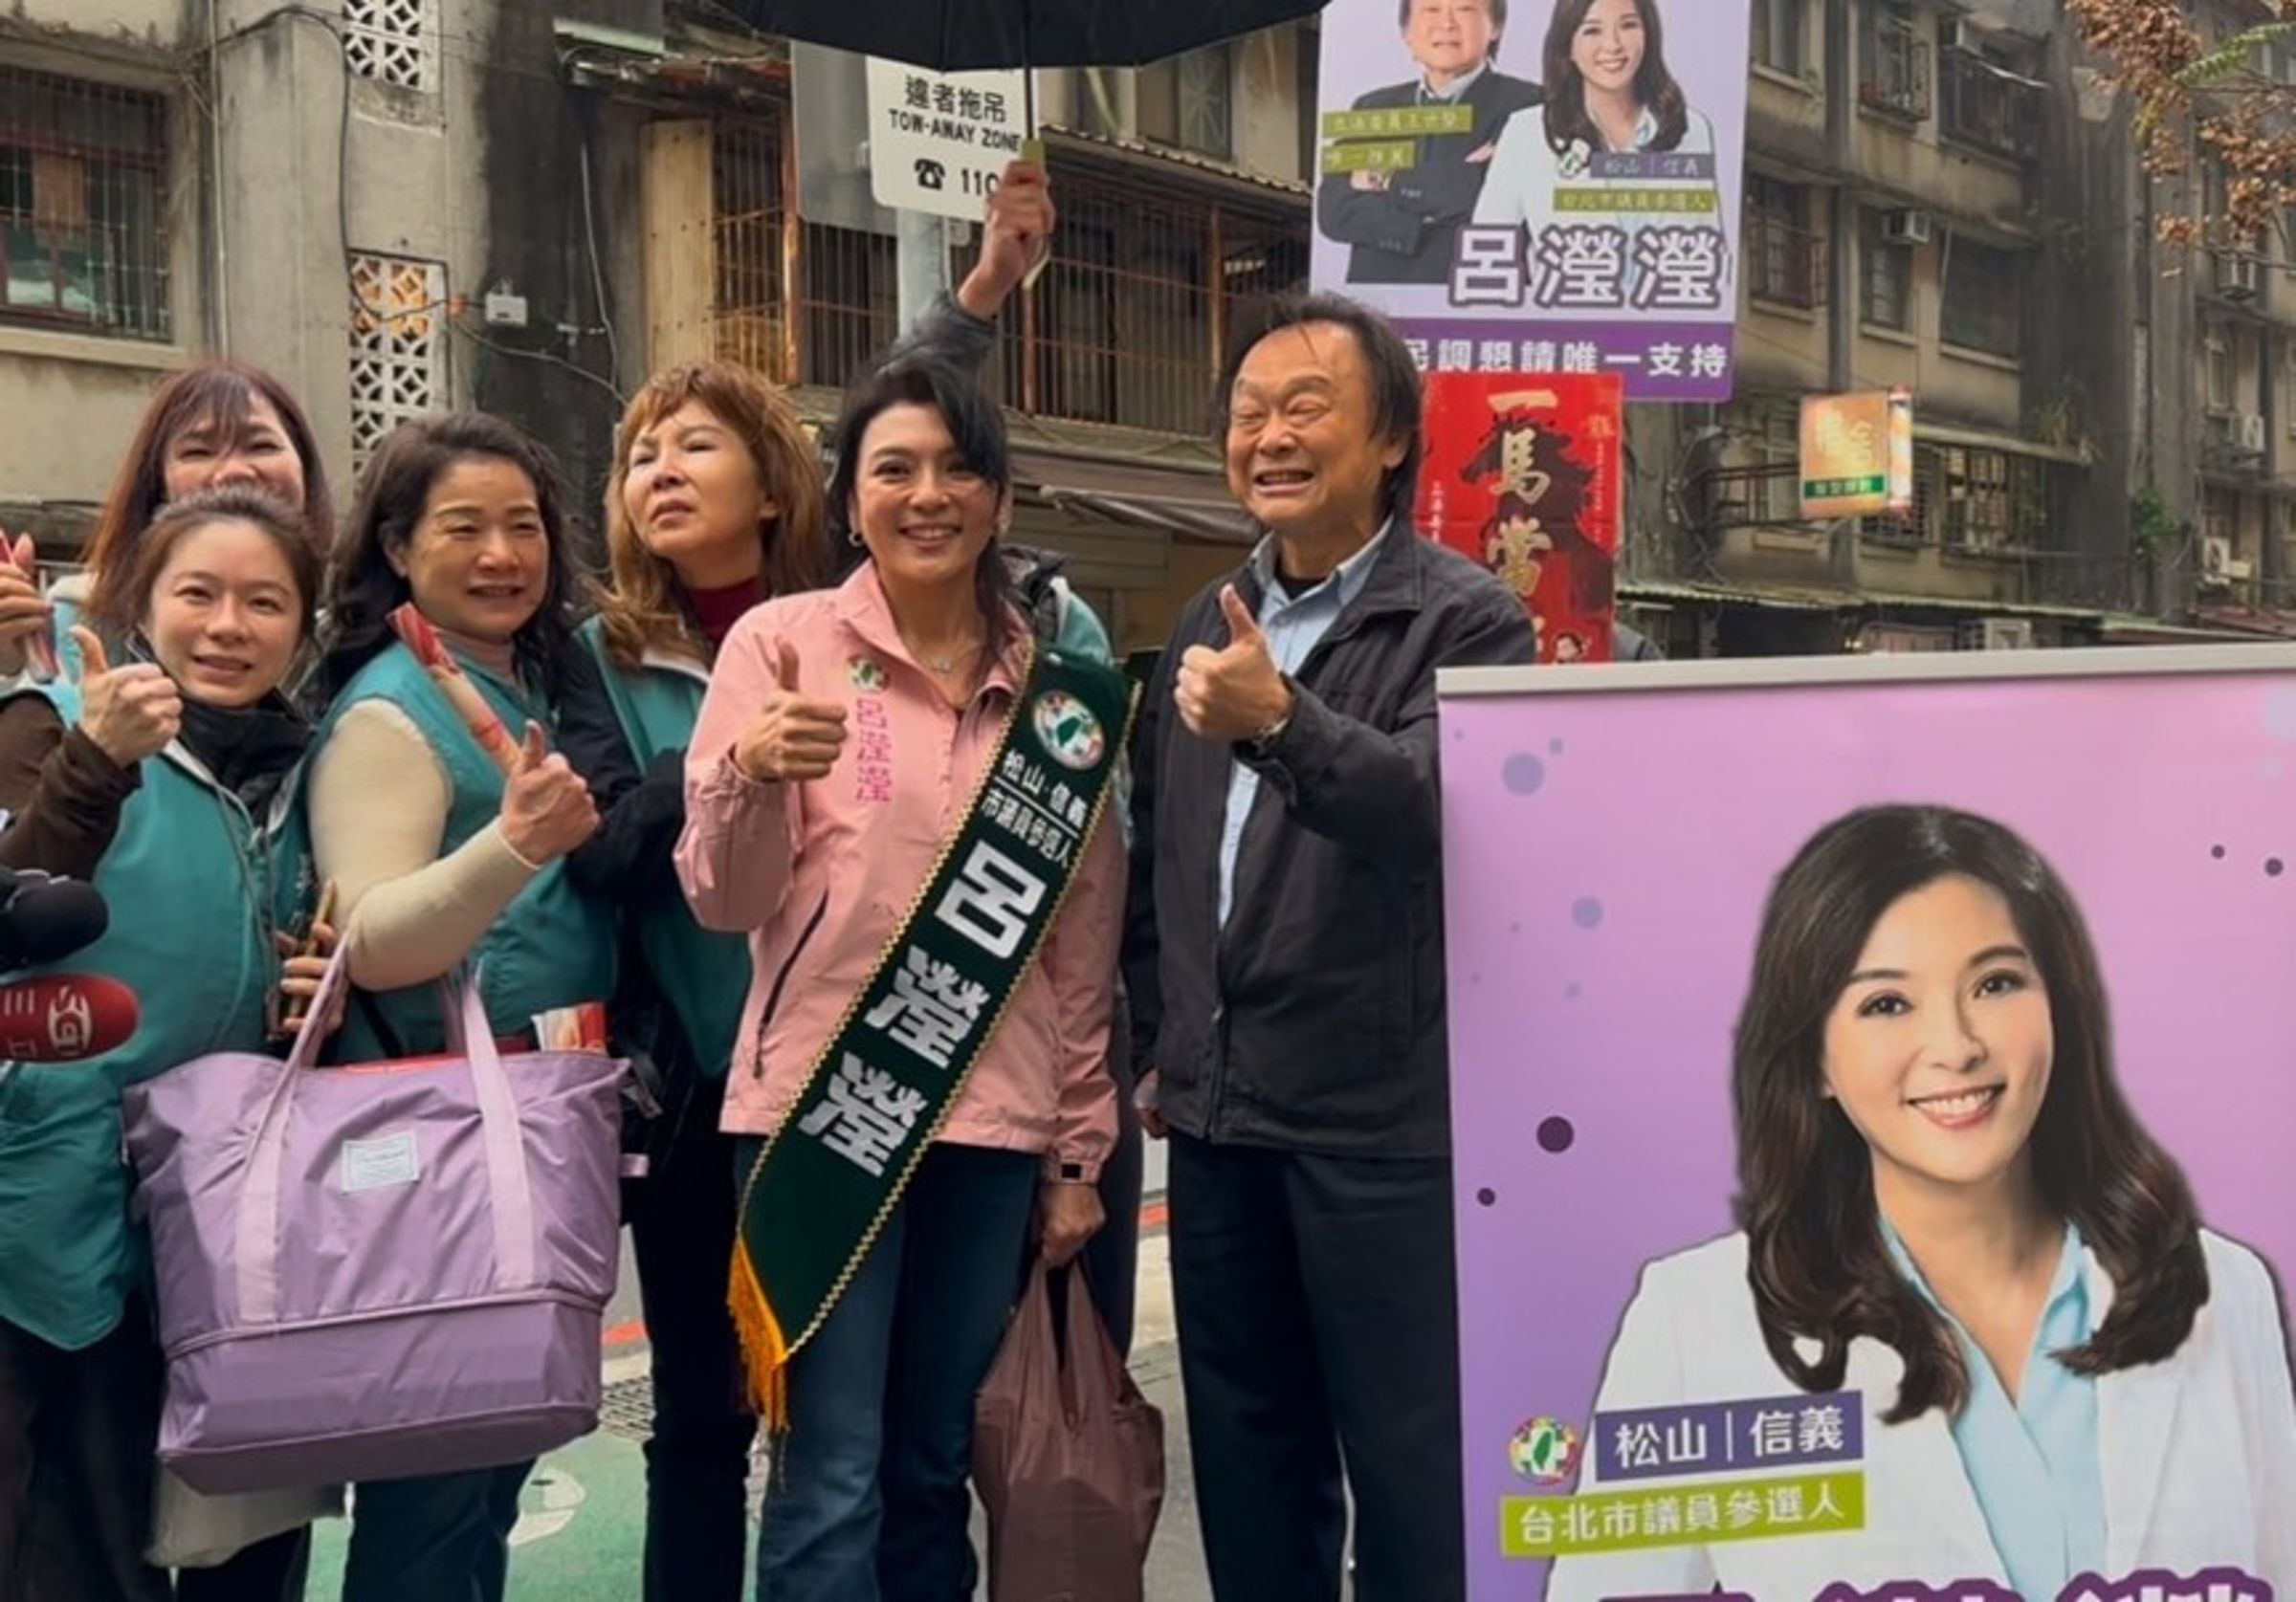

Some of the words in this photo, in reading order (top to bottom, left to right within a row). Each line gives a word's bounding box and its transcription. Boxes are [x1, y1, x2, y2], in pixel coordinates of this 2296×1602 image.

[889, 108, 975, 143] TOW-AWAY
[982, 127, 1021, 152] ZONE
[905, 76, 1006, 122] 違者拖吊
[1451, 227, 1720, 307] 呂瀅瀅
[1486, 389, 1560, 654] 一馬當
[798, 840, 1047, 1177] 呂瀅瀅
[1614, 1417, 1707, 1469] 松山
[1750, 1405, 1843, 1458] 信義
[1519, 1481, 1844, 1545] 台北市議員參選人
